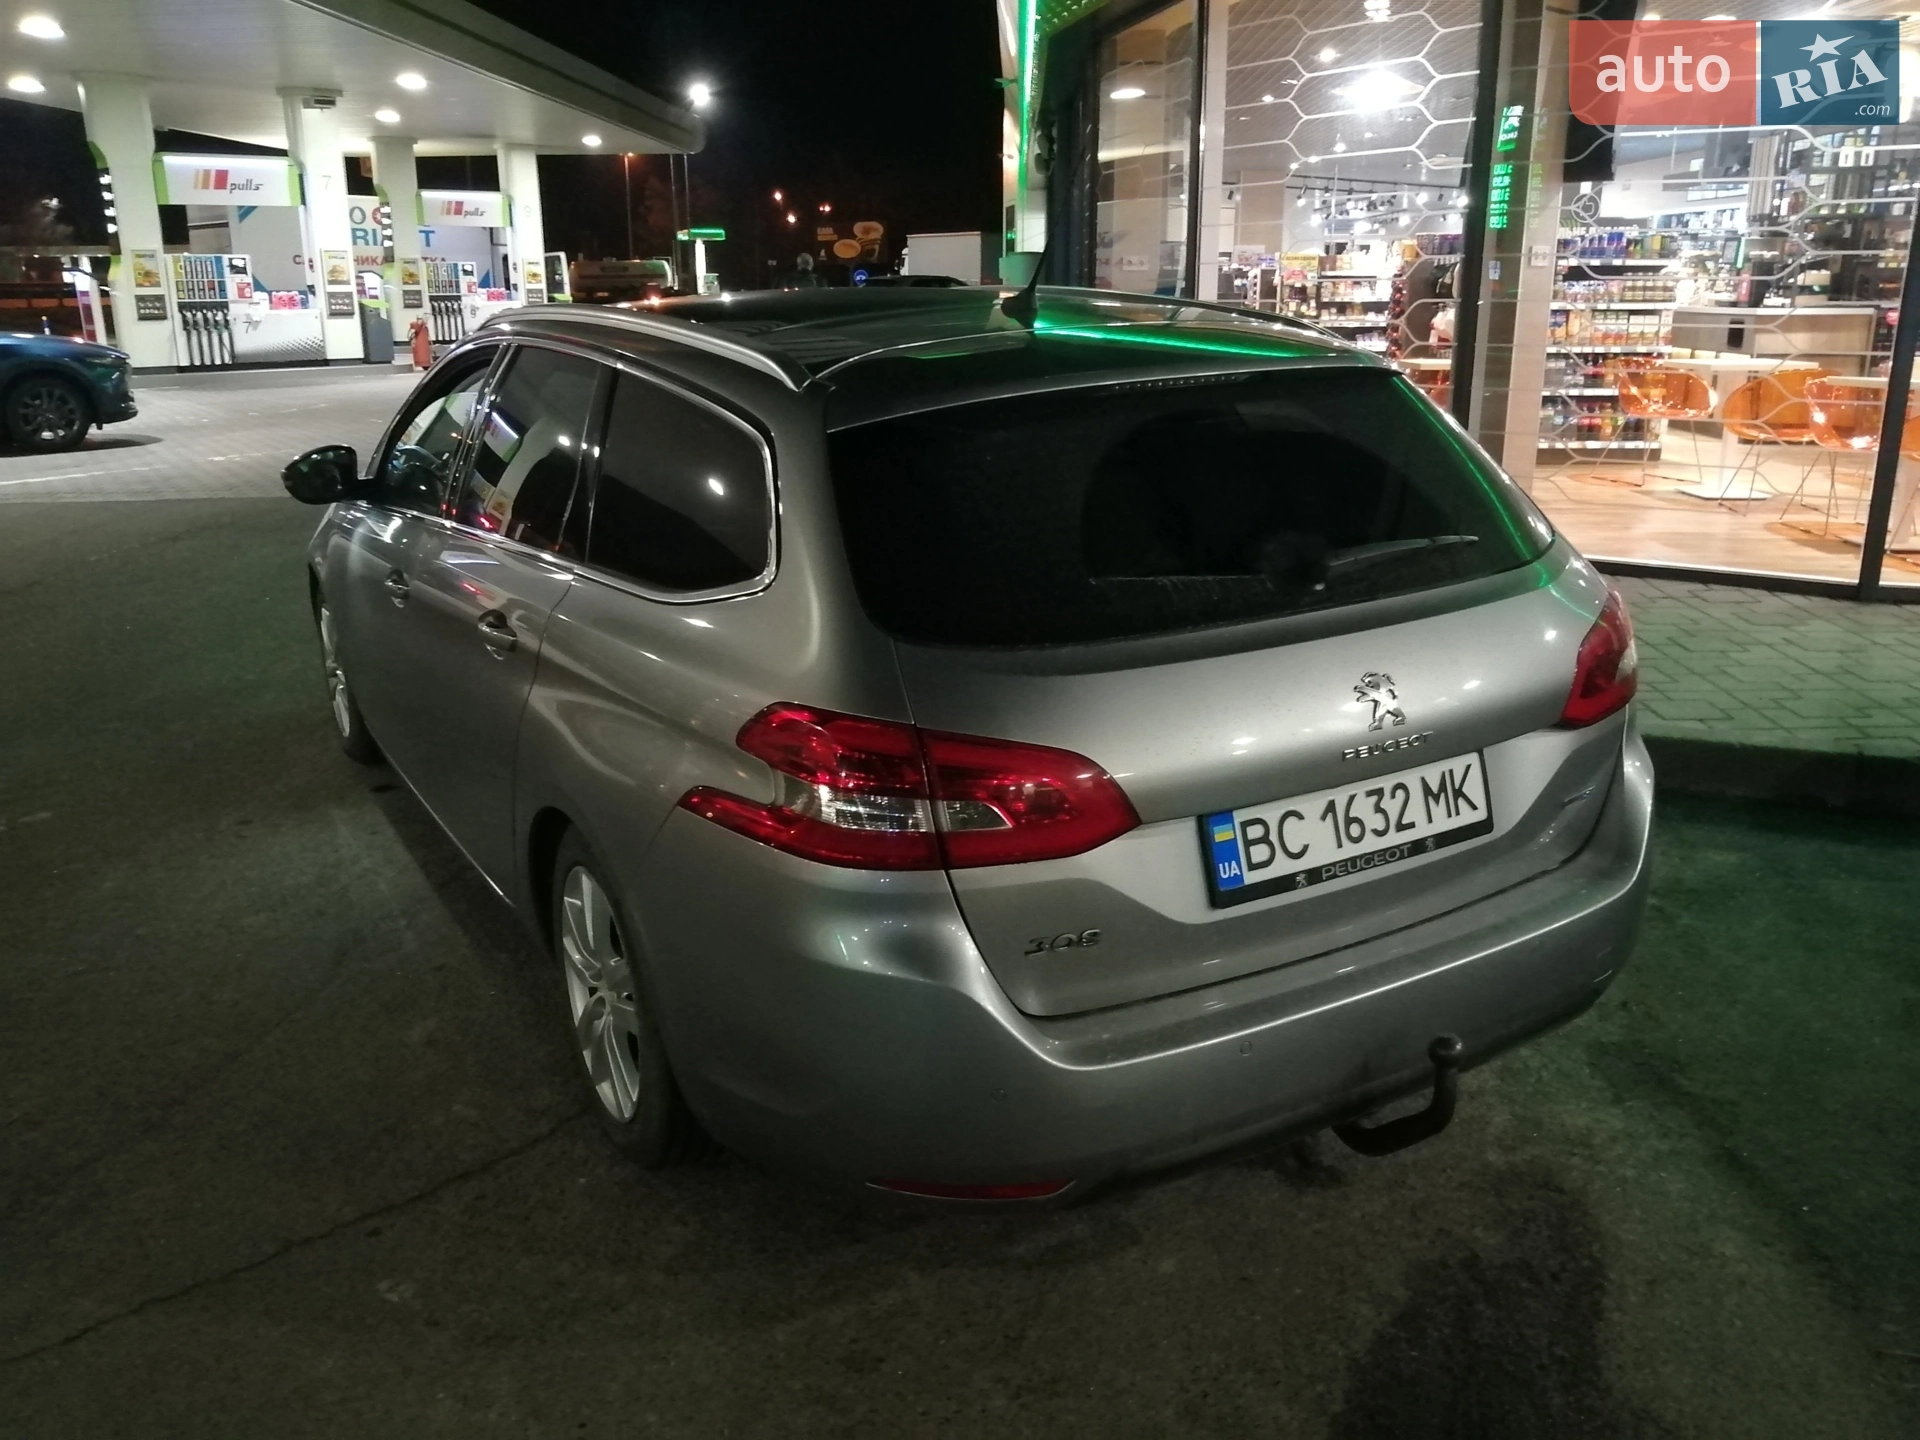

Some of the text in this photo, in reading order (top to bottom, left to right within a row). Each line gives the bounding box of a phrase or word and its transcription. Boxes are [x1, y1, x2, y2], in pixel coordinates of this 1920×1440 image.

[229, 178, 264, 194] pulls
[463, 207, 487, 219] pulls
[242, 321, 252, 334] 7
[1342, 731, 1434, 762] PEUGEOT
[1240, 763, 1479, 872] BC 1632 MK
[1218, 860, 1241, 880] UA
[1322, 843, 1412, 881] PEUGEOT
[1024, 927, 1102, 957] 308
